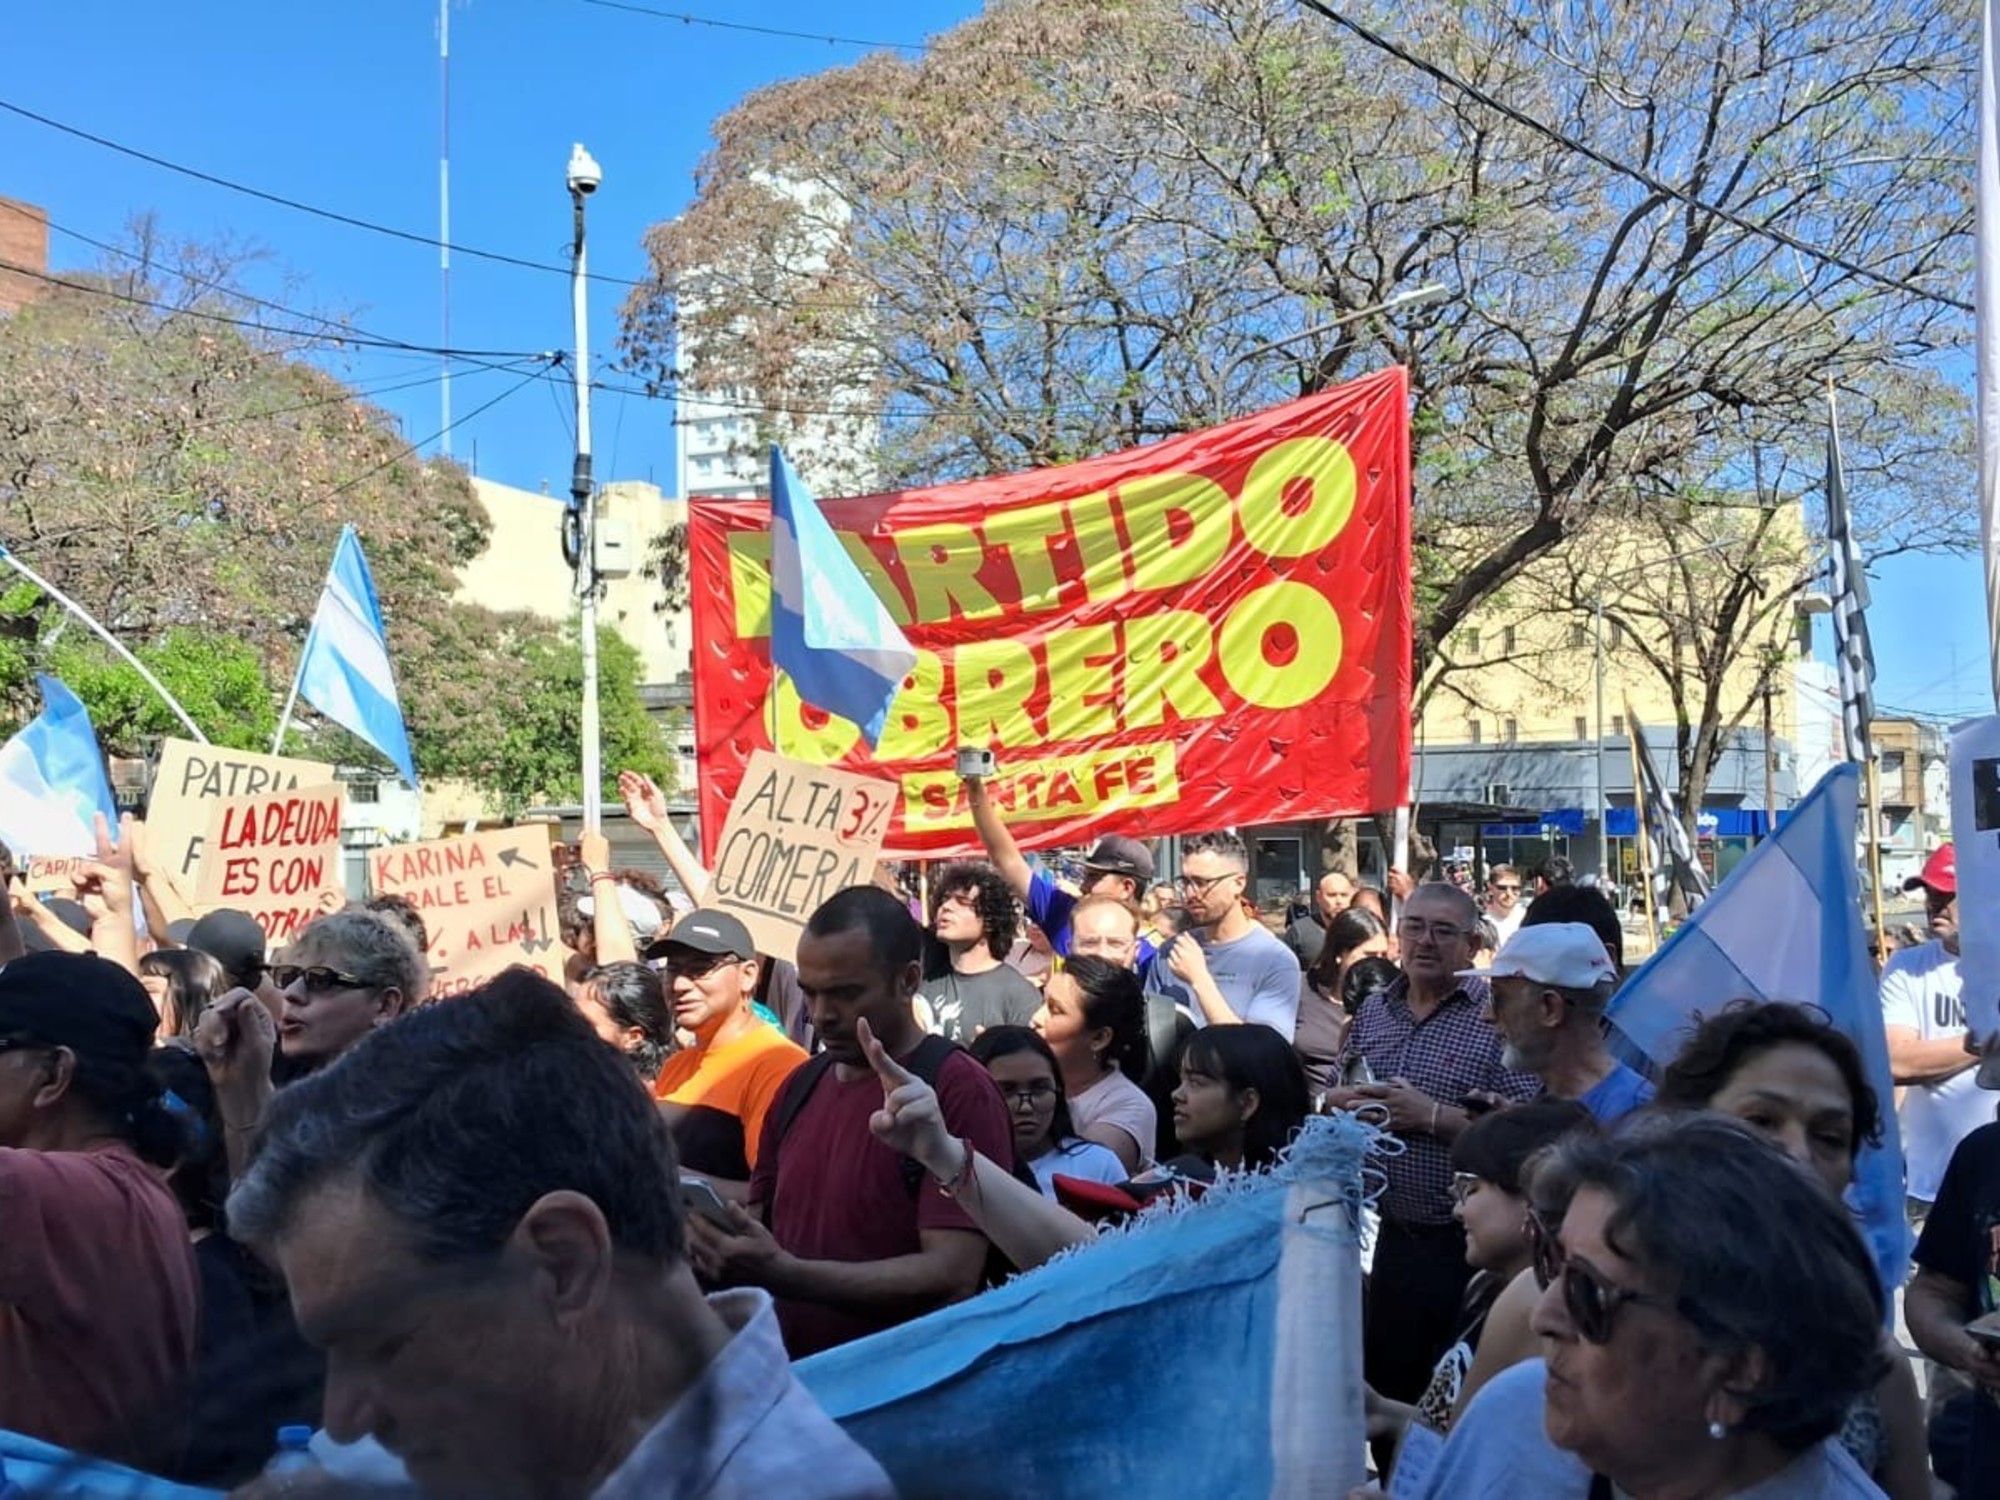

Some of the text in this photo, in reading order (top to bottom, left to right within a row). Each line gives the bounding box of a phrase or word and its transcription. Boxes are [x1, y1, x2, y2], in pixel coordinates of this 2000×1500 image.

[1093, 755, 1156, 801] FE
[219, 796, 340, 850] LA DEUDA
[741, 768, 889, 840] ALTA 3%
[221, 854, 323, 896] ES CON
[375, 842, 486, 888] KARINA
[483, 875, 511, 899] EL
[467, 929, 482, 951] A
[1935, 992, 1968, 1027] UN
